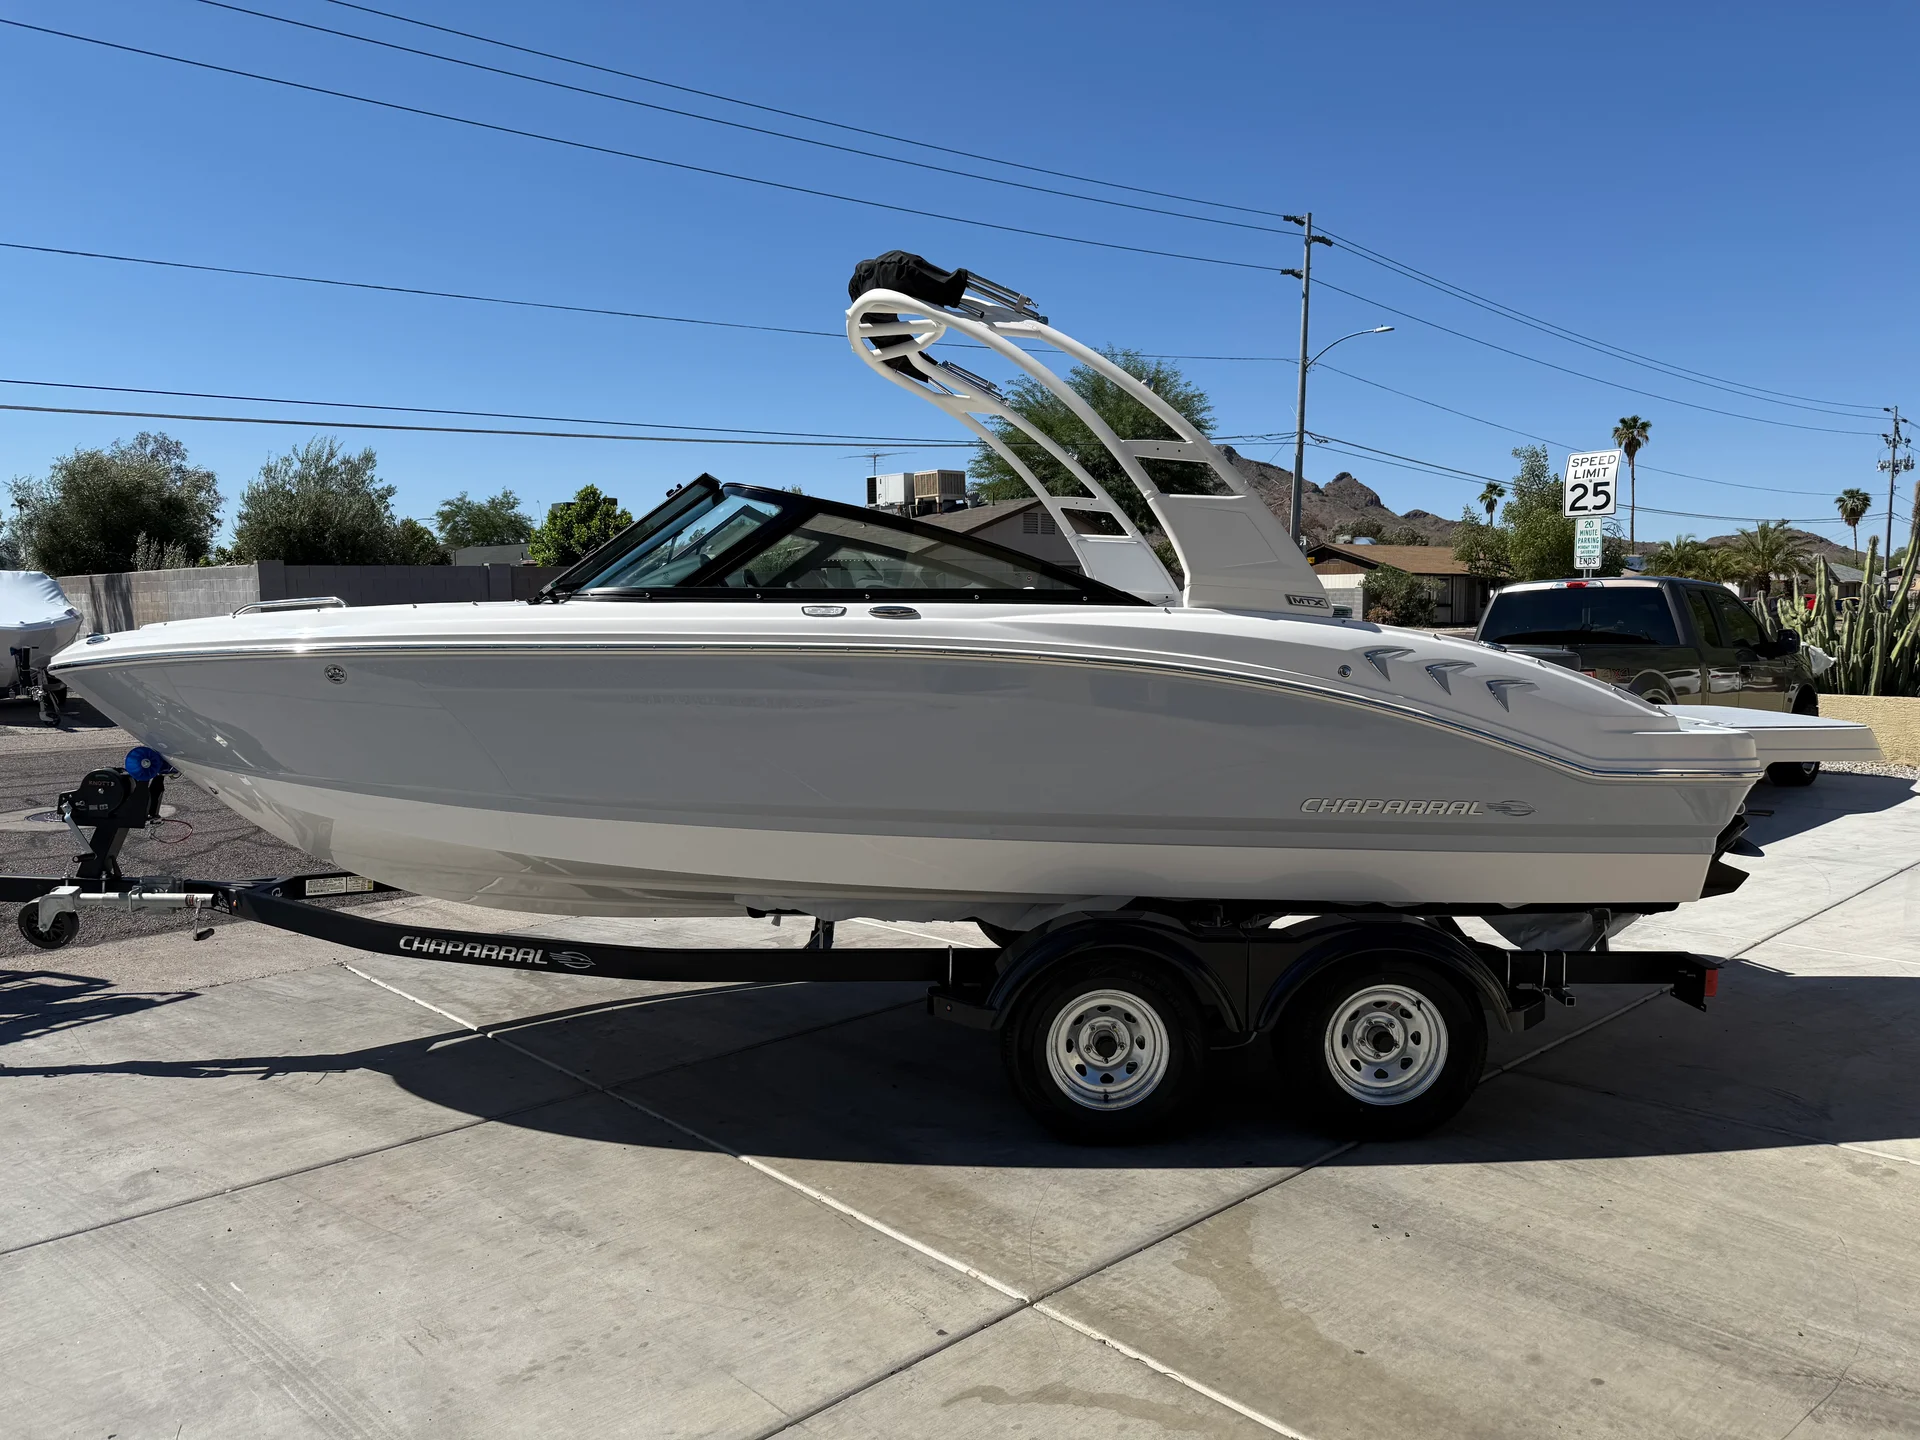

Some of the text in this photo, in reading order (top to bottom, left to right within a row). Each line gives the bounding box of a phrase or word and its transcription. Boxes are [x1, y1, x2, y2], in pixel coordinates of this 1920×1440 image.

[1571, 455, 1616, 467] SPEED
[1574, 467, 1609, 479] LIMIT
[1569, 482, 1611, 512] 25
[1584, 520, 1594, 529] 20
[1579, 557, 1597, 566] ENDS
[1291, 597, 1324, 606] MTX
[1300, 797, 1483, 816] CHAPARRAL
[399, 935, 548, 965] CHAPARRAL
